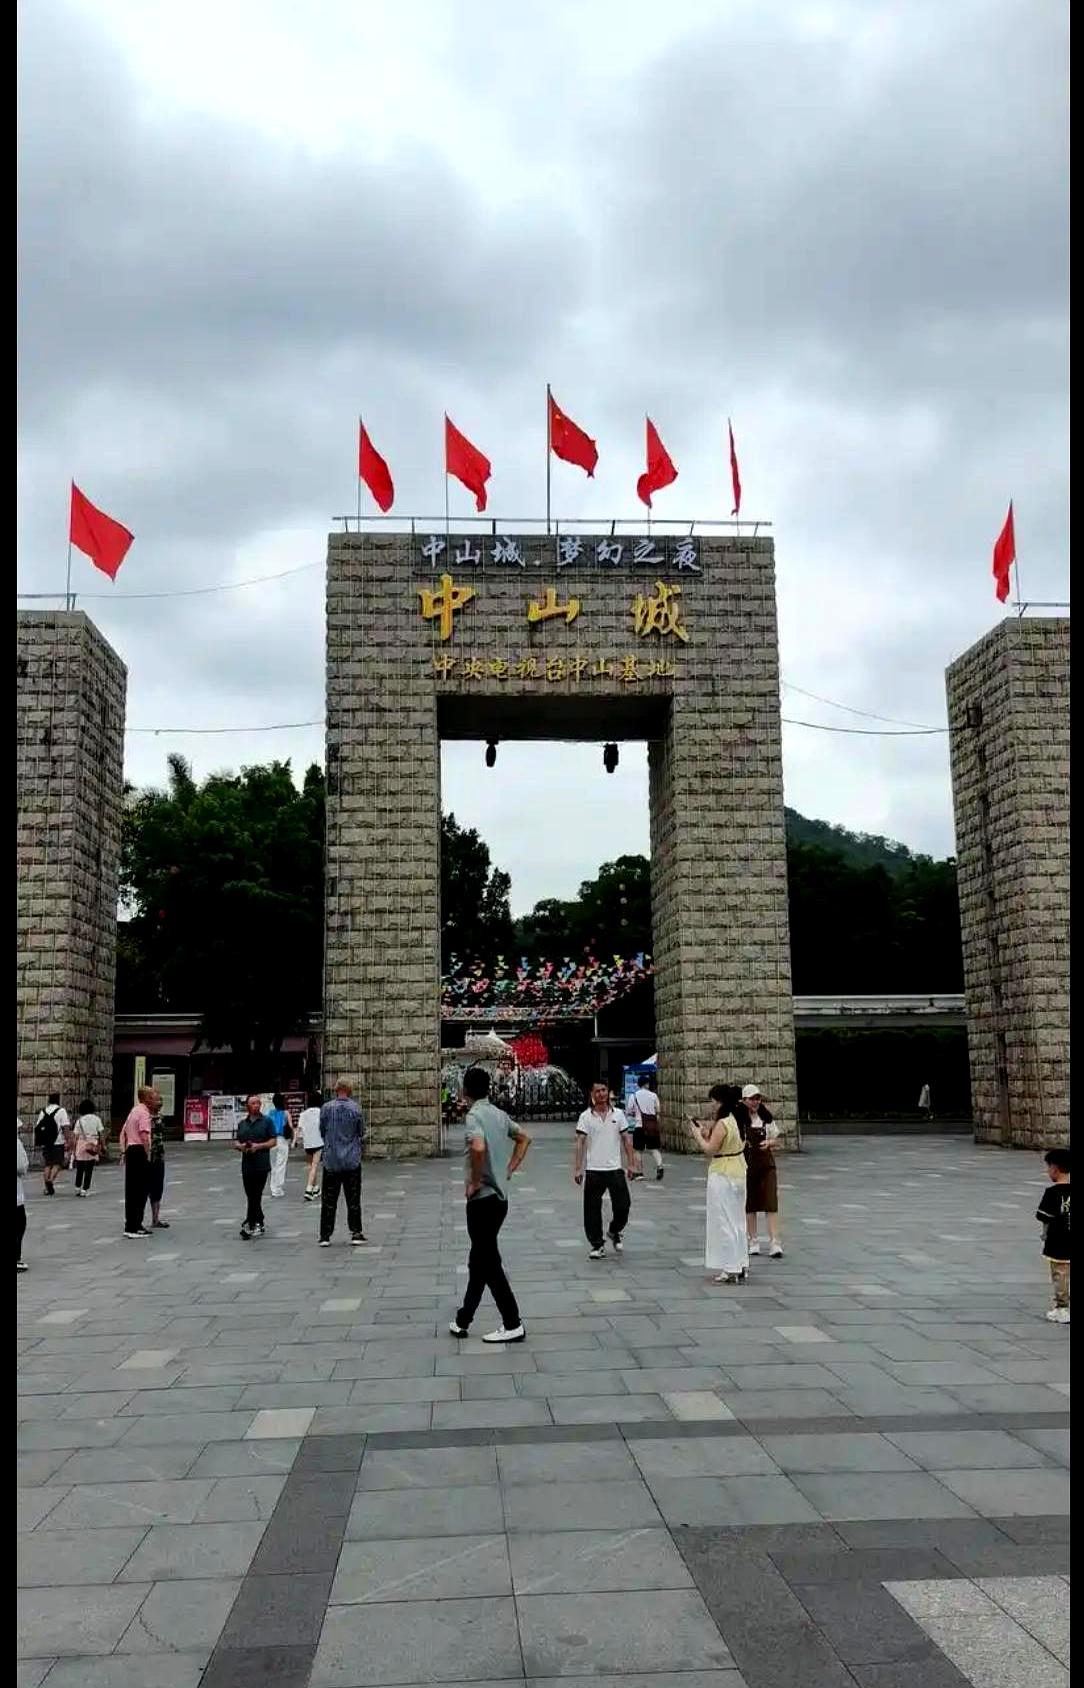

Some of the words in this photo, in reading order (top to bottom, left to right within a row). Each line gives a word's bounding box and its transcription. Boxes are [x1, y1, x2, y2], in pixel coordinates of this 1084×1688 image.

[418, 573, 690, 642] 中山城
[434, 655, 675, 683] 中央电视台中山基地
